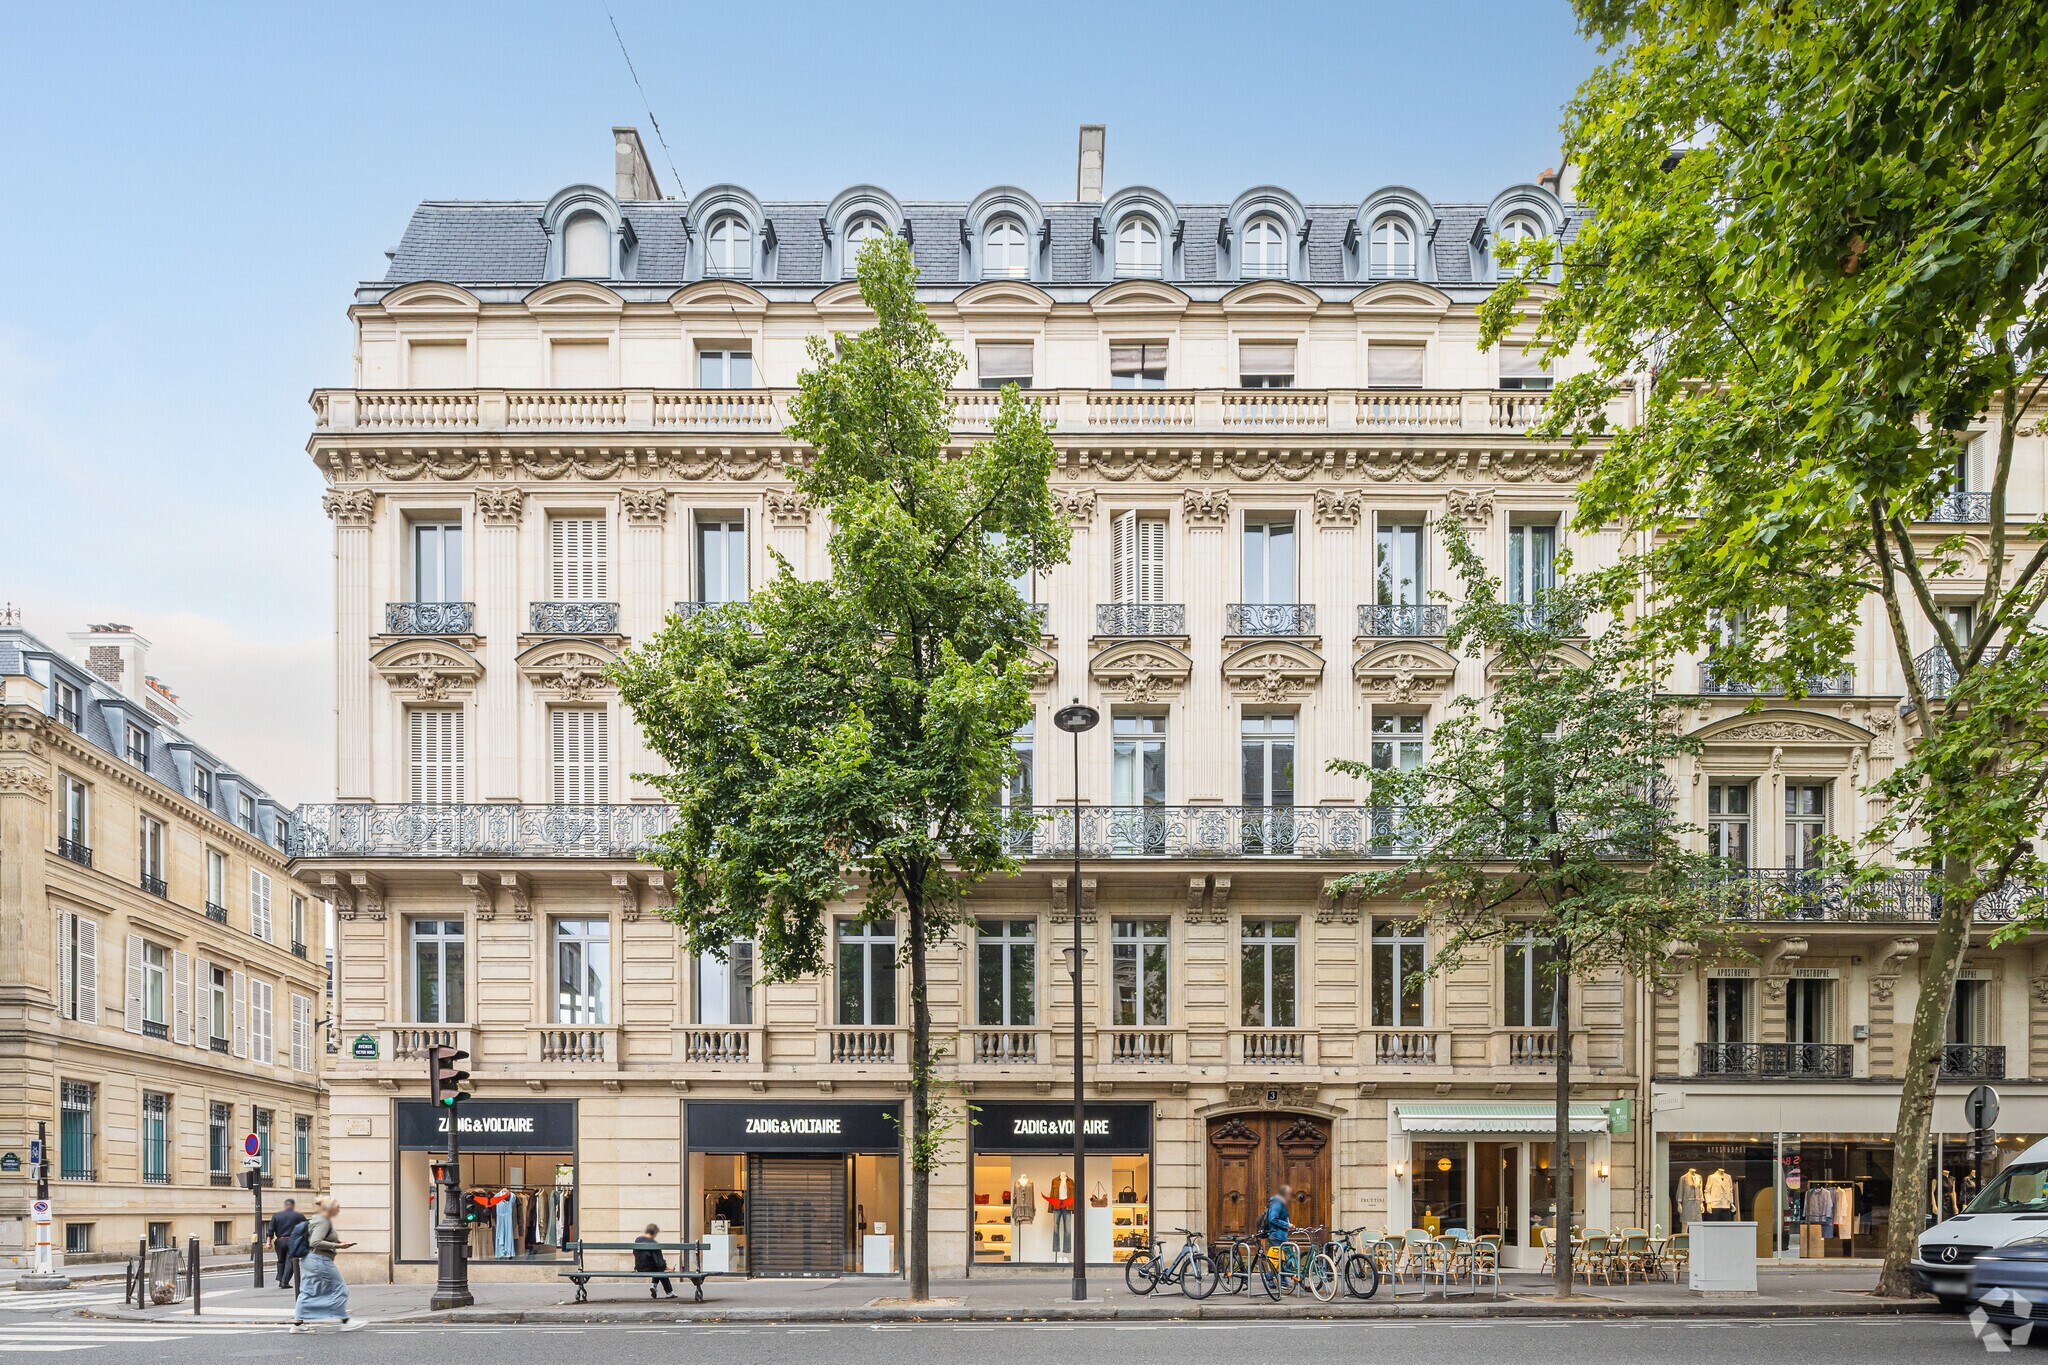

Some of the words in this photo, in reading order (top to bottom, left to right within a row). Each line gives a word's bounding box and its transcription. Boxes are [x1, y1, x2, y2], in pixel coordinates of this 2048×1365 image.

[1717, 968, 1750, 977] APOSTROPHE
[1796, 969, 1829, 977] APOSTROPHE
[745, 1118, 842, 1134] ZADIG&VOLTAIRE
[1013, 1119, 1110, 1134] ZADIG&VOLAIRE
